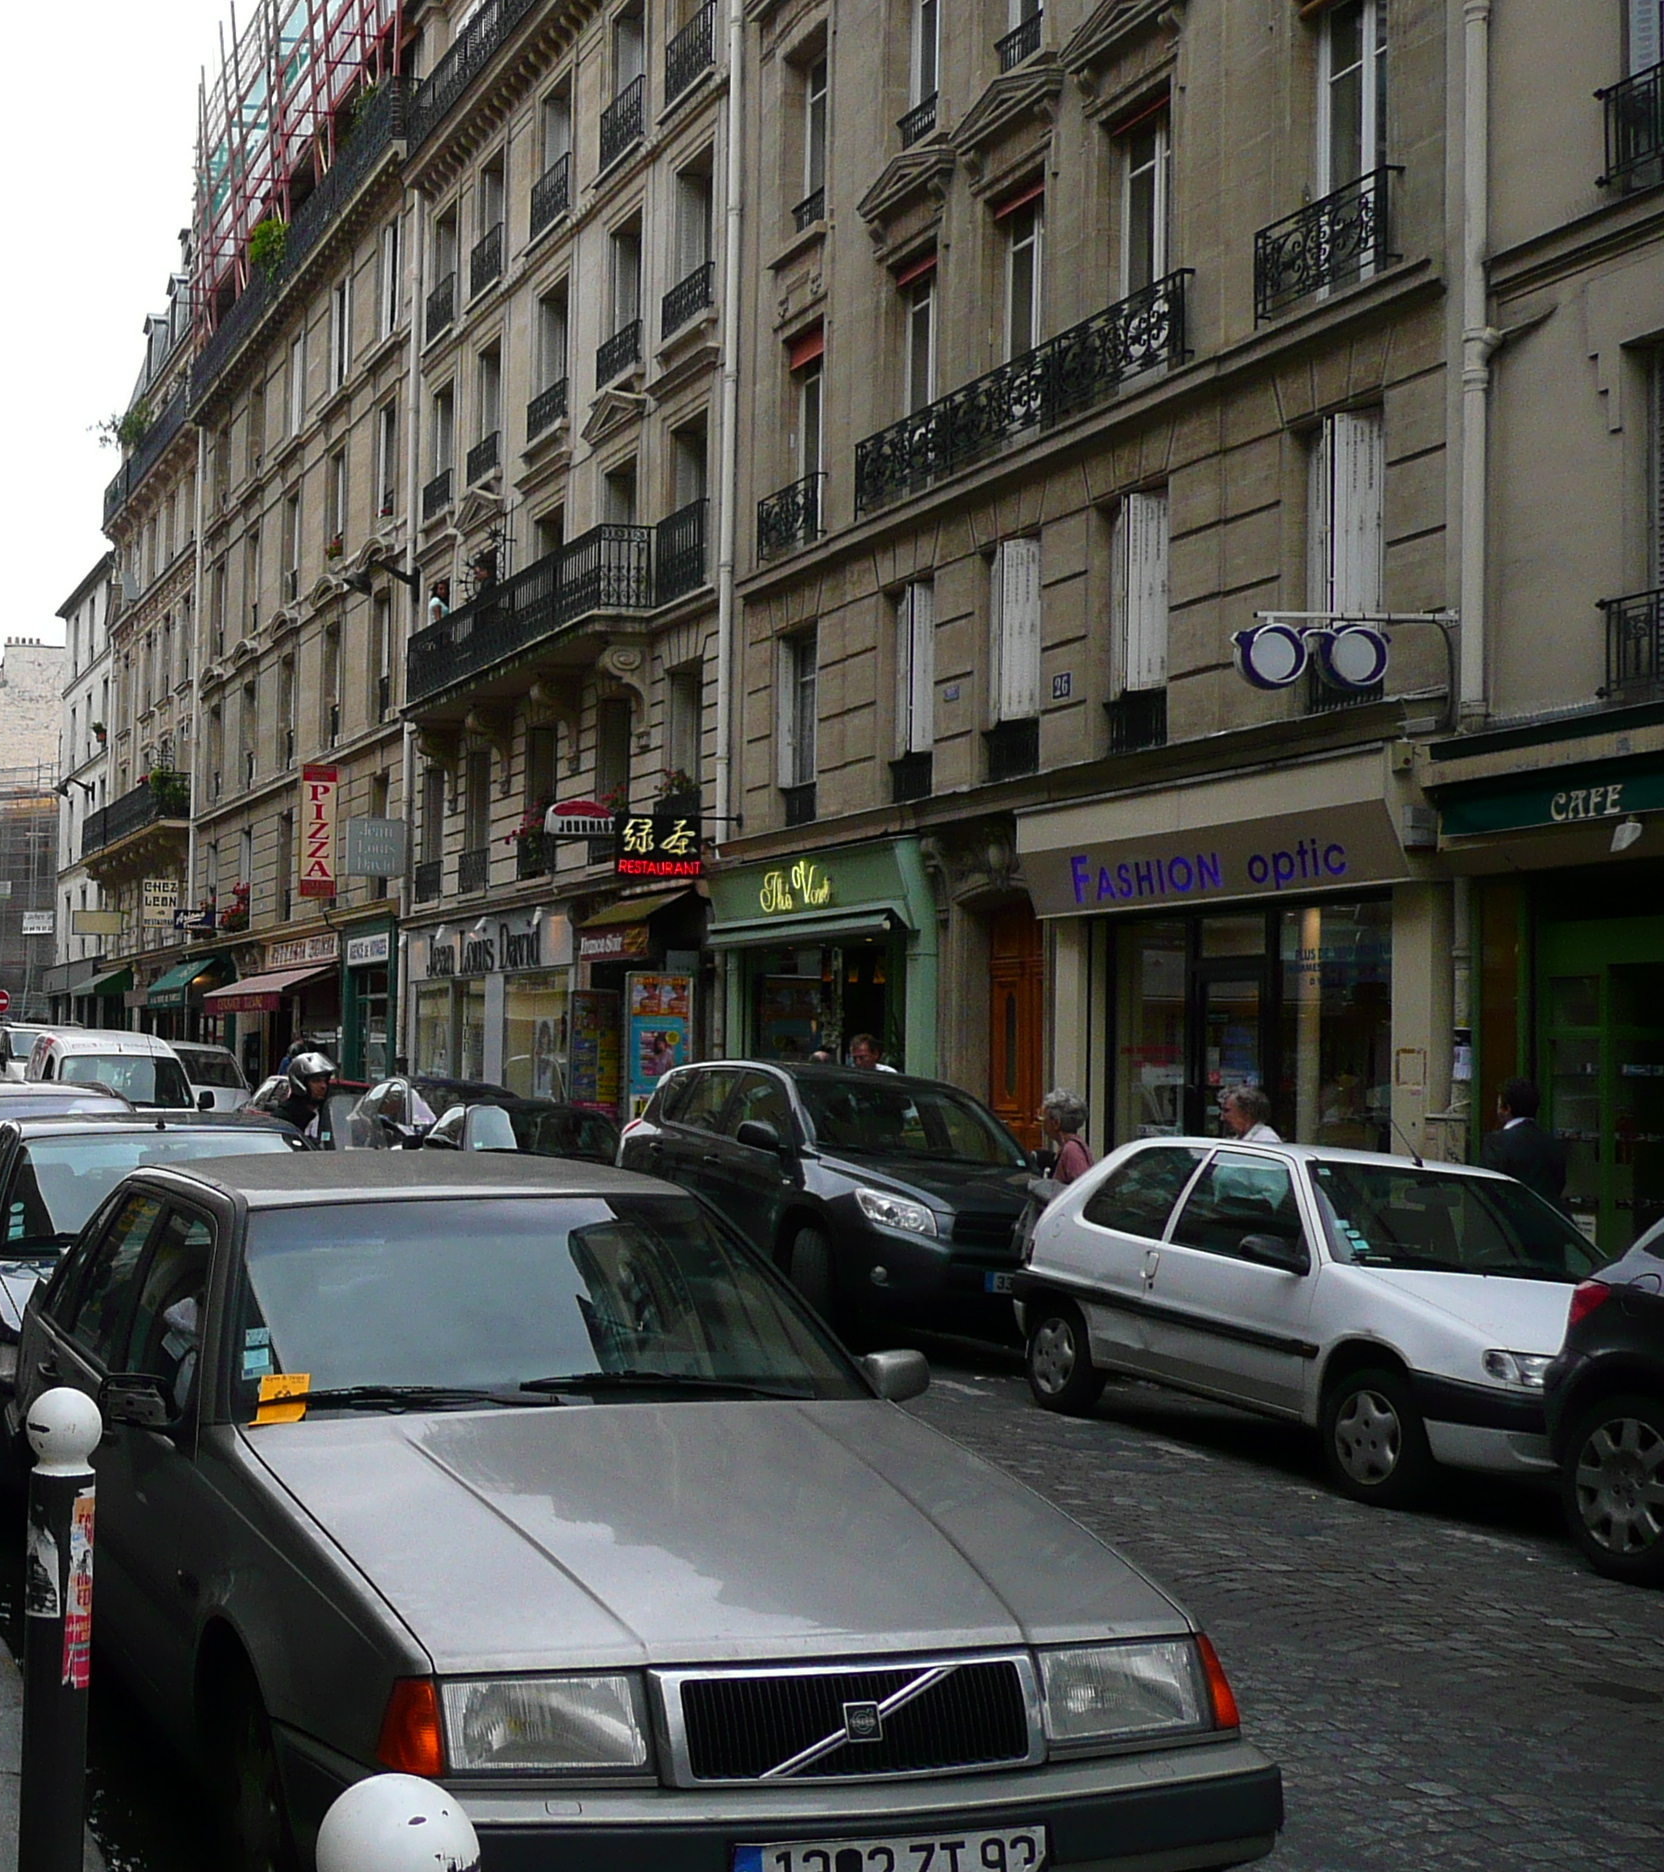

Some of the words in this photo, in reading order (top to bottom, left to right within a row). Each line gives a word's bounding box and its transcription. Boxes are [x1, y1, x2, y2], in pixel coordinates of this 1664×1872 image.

[1054, 676, 1069, 697] 26
[1551, 784, 1623, 821] CAFE
[304, 784, 332, 878] PIZZA
[359, 821, 394, 838] Jean
[358, 840, 396, 854] Louis
[357, 857, 396, 871] David
[618, 858, 701, 876] RESTAURANT
[1247, 838, 1348, 890] optic
[144, 881, 178, 893] CHEZ
[144, 896, 176, 907] LEON
[426, 934, 455, 977] Jean
[458, 926, 494, 975] Louis
[497, 918, 541, 970] David
